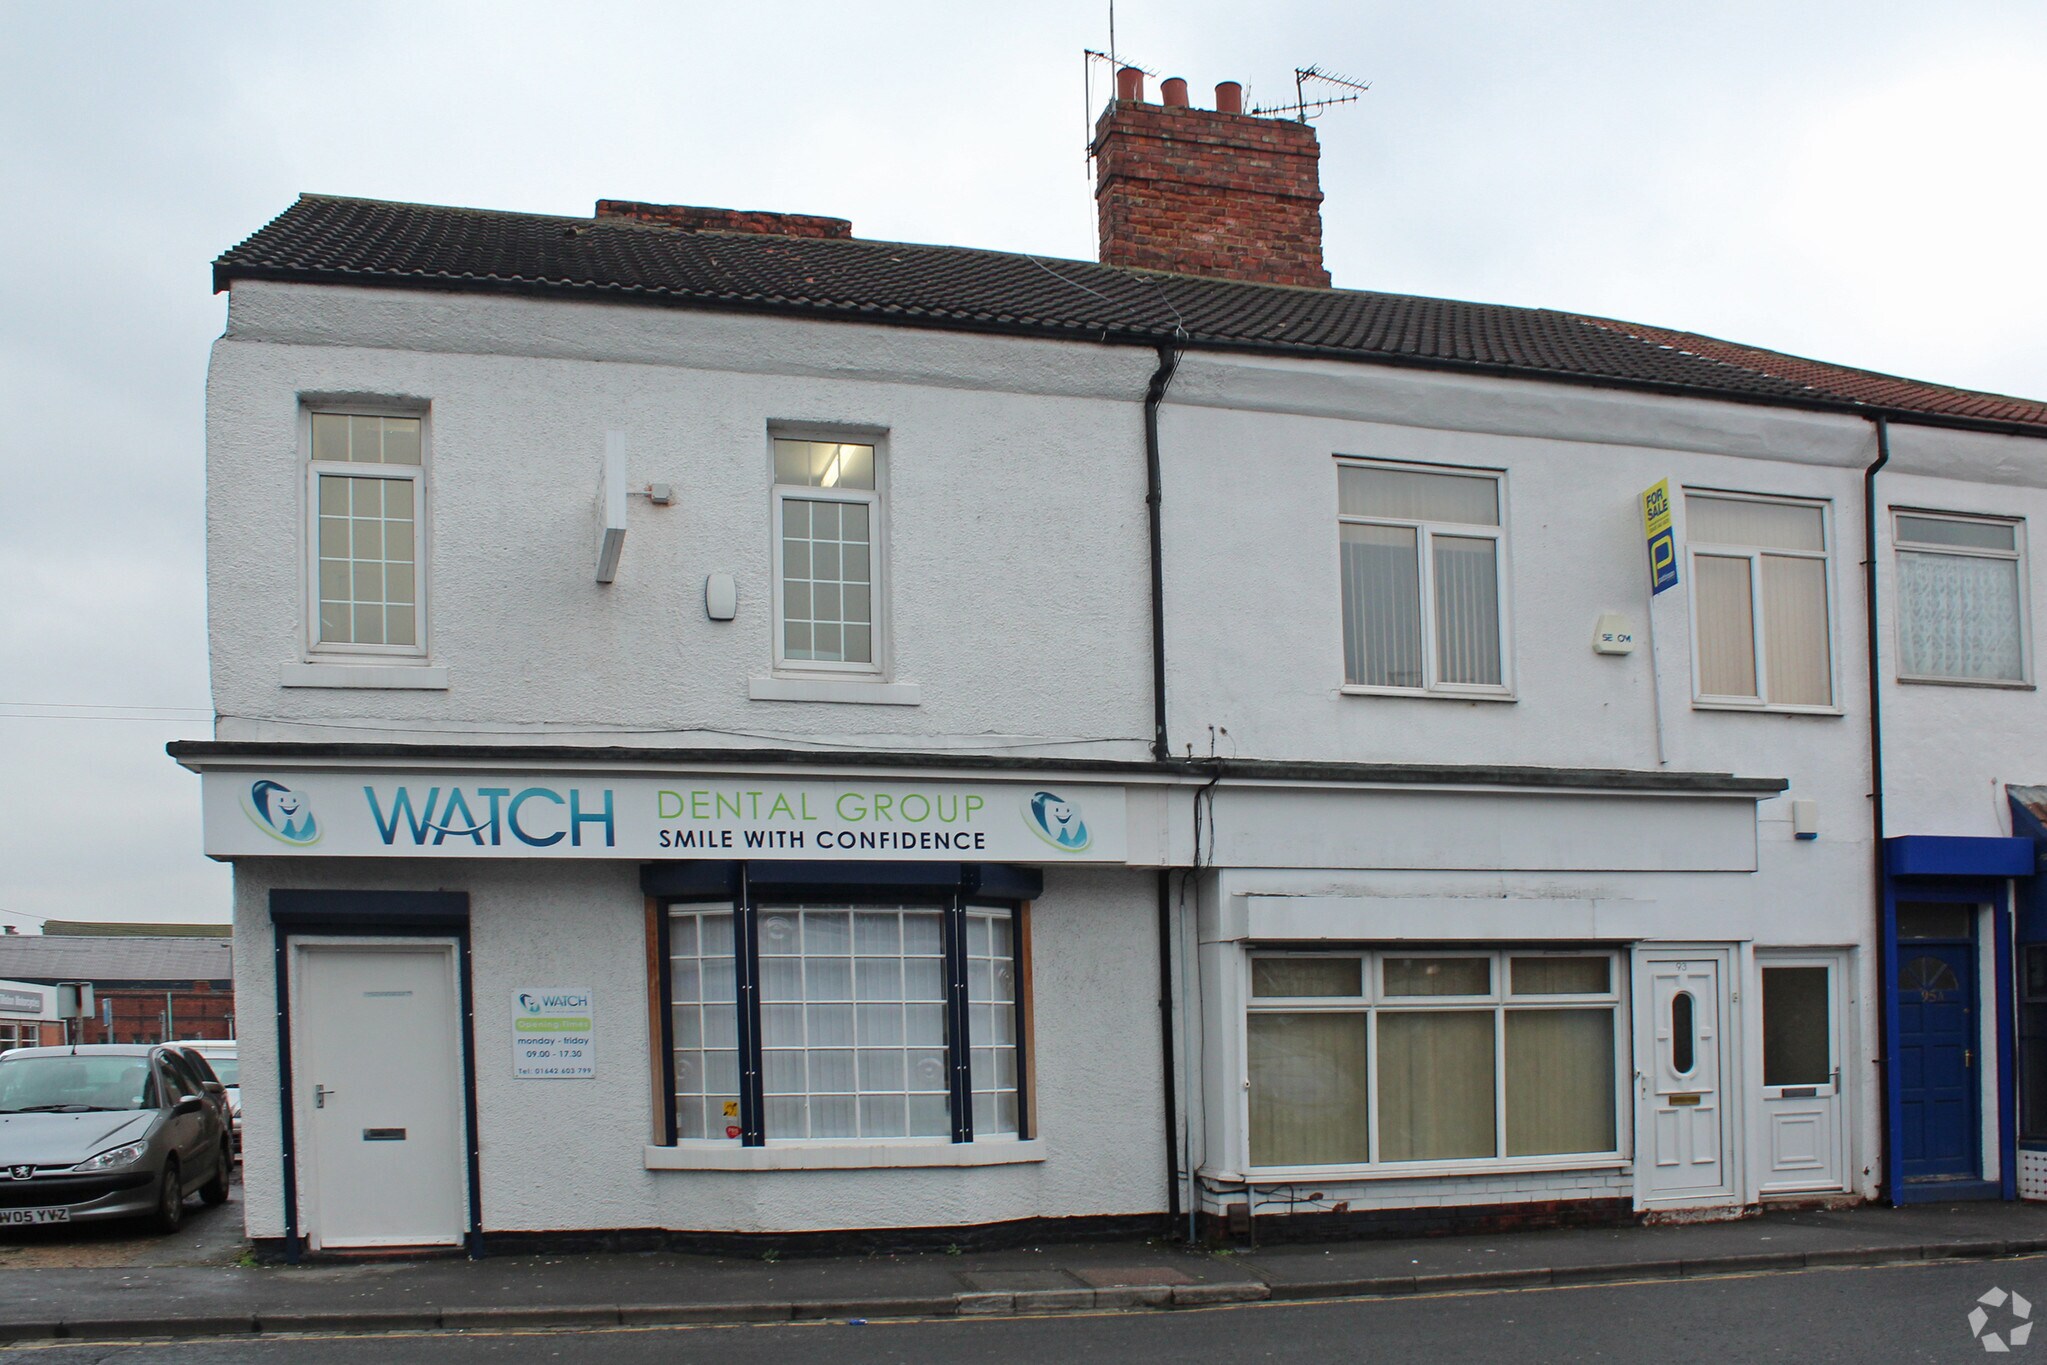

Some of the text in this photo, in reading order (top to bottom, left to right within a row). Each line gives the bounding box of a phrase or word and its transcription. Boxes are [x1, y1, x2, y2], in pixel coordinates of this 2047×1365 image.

[1646, 488, 1663, 508] FOR
[1647, 499, 1668, 521] SALE
[363, 786, 615, 847] WATCH
[657, 790, 984, 823] DENTAL GROUP
[659, 830, 985, 850] SMILE WITH CONFIDENCE
[1675, 962, 1687, 971] 93
[542, 996, 587, 1006] WATCH
[518, 1037, 555, 1046] monday
[563, 1037, 589, 1046] friday
[559, 1050, 582, 1058] 17.30
